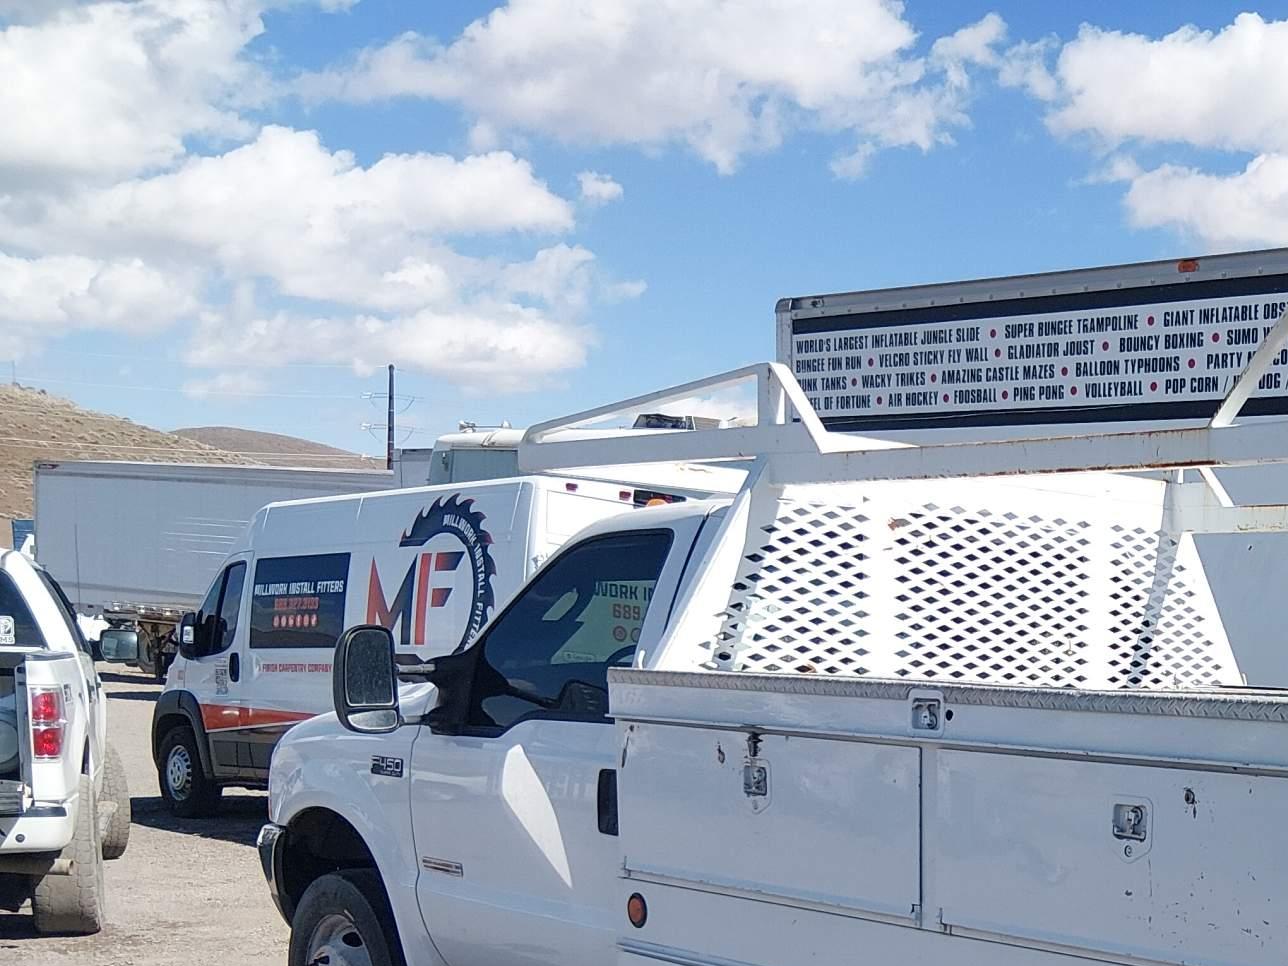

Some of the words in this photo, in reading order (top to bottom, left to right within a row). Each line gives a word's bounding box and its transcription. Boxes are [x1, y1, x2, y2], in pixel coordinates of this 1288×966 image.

[796, 338, 831, 354] WORLD'S
[834, 335, 868, 352] LARGEST
[871, 333, 917, 349] INFLATABLE
[921, 329, 953, 345] JUNGLE
[956, 327, 981, 343] SLIDE
[1005, 322, 1034, 338] SUPER
[1038, 320, 1073, 336] BUNGEE
[1077, 314, 1138, 334] TRAMPOLINE
[1163, 309, 1195, 327] GIANT
[1199, 304, 1259, 324] INFLATABLE
[796, 358, 825, 373] BUNGEE
[828, 357, 843, 371] FUN
[846, 356, 862, 370] RUN
[879, 352, 910, 368] VELCRO
[913, 350, 945, 366] STICKY
[948, 349, 962, 364] FLY
[965, 347, 989, 362] WALL
[1008, 342, 1060, 360] GLADIATOR
[1063, 340, 1095, 357] JOUST
[1119, 335, 1160, 352] BOUNCY
[1165, 332, 1204, 350] BOXING
[1227, 327, 1258, 345] SUMO
[821, 376, 847, 391] TANKS
[862, 373, 893, 389] WACKY
[895, 372, 926, 386] TRIKES
[941, 369, 982, 385] AMAZING
[986, 366, 1019, 382] CASTLE
[1023, 364, 1055, 380] MAZES
[1075, 360, 1120, 377] BALLOON
[1124, 356, 1180, 375] TYPHOONS
[1206, 352, 1242, 370] PARTY
[824, 396, 833, 410] OF
[836, 394, 871, 409] FORTUNE
[888, 393, 902, 407] AIR
[906, 391, 938, 406] HOCKEY
[954, 388, 997, 404] FOOSBALL
[1013, 386, 1035, 402] PING
[1039, 385, 1064, 400] PONG
[1085, 380, 1143, 399] VOLLEYBALL
[1165, 378, 1186, 394] POP
[1190, 376, 1219, 393] CORN
